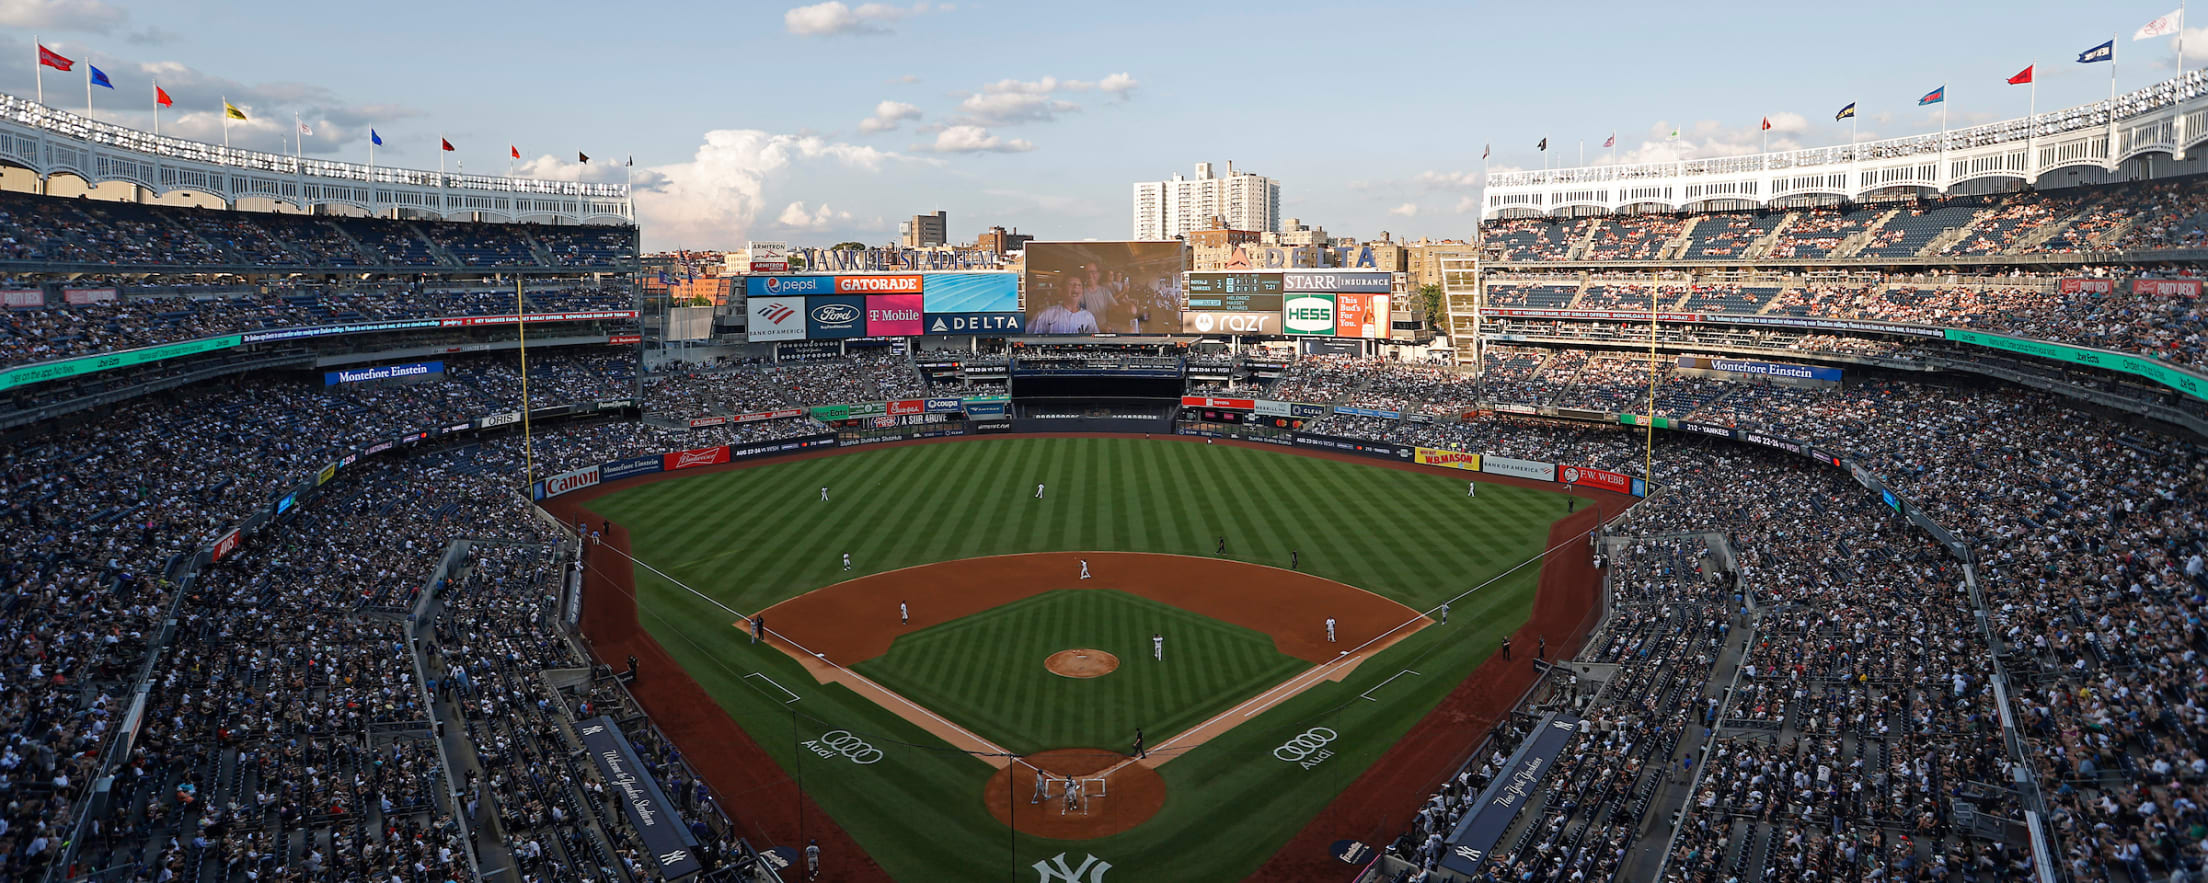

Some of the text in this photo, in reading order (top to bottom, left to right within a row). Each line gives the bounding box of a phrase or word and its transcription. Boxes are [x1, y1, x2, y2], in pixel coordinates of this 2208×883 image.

[803, 249, 994, 272] YANKEE STADIUM
[1266, 247, 1377, 268] DELTA
[782, 279, 817, 292] pepsi
[840, 278, 917, 290] GATORADE
[1284, 275, 1337, 289] STARR
[2157, 282, 2196, 296] PARTY DECK
[820, 306, 852, 320] Ford
[882, 310, 919, 321] Mobile
[1288, 308, 1330, 320] HESS
[954, 316, 1018, 330] DELTA
[1220, 315, 1270, 331] razr
[339, 364, 428, 383] Montefiore Einstein
[1711, 359, 1812, 378] Montefiore Einstein
[488, 415, 513, 426] ORIS
[1702, 426, 1730, 437] YANKEES
[1748, 434, 1761, 443] AUG
[1786, 444, 1800, 453] WSH
[603, 463, 633, 474] Montefiore
[634, 459, 658, 468] Einstein
[1511, 465, 1538, 473] AMERICA
[546, 470, 598, 494] Canon
[1599, 473, 1624, 485] WEBB
[218, 534, 235, 557] AVIS
[800, 740, 837, 759] Audi
[602, 750, 622, 773] Welcome
[1300, 748, 1335, 770] Audi
[611, 776, 644, 799] Yankee
[1493, 757, 1544, 808] New York Yankees
[632, 800, 655, 826] Stadium
